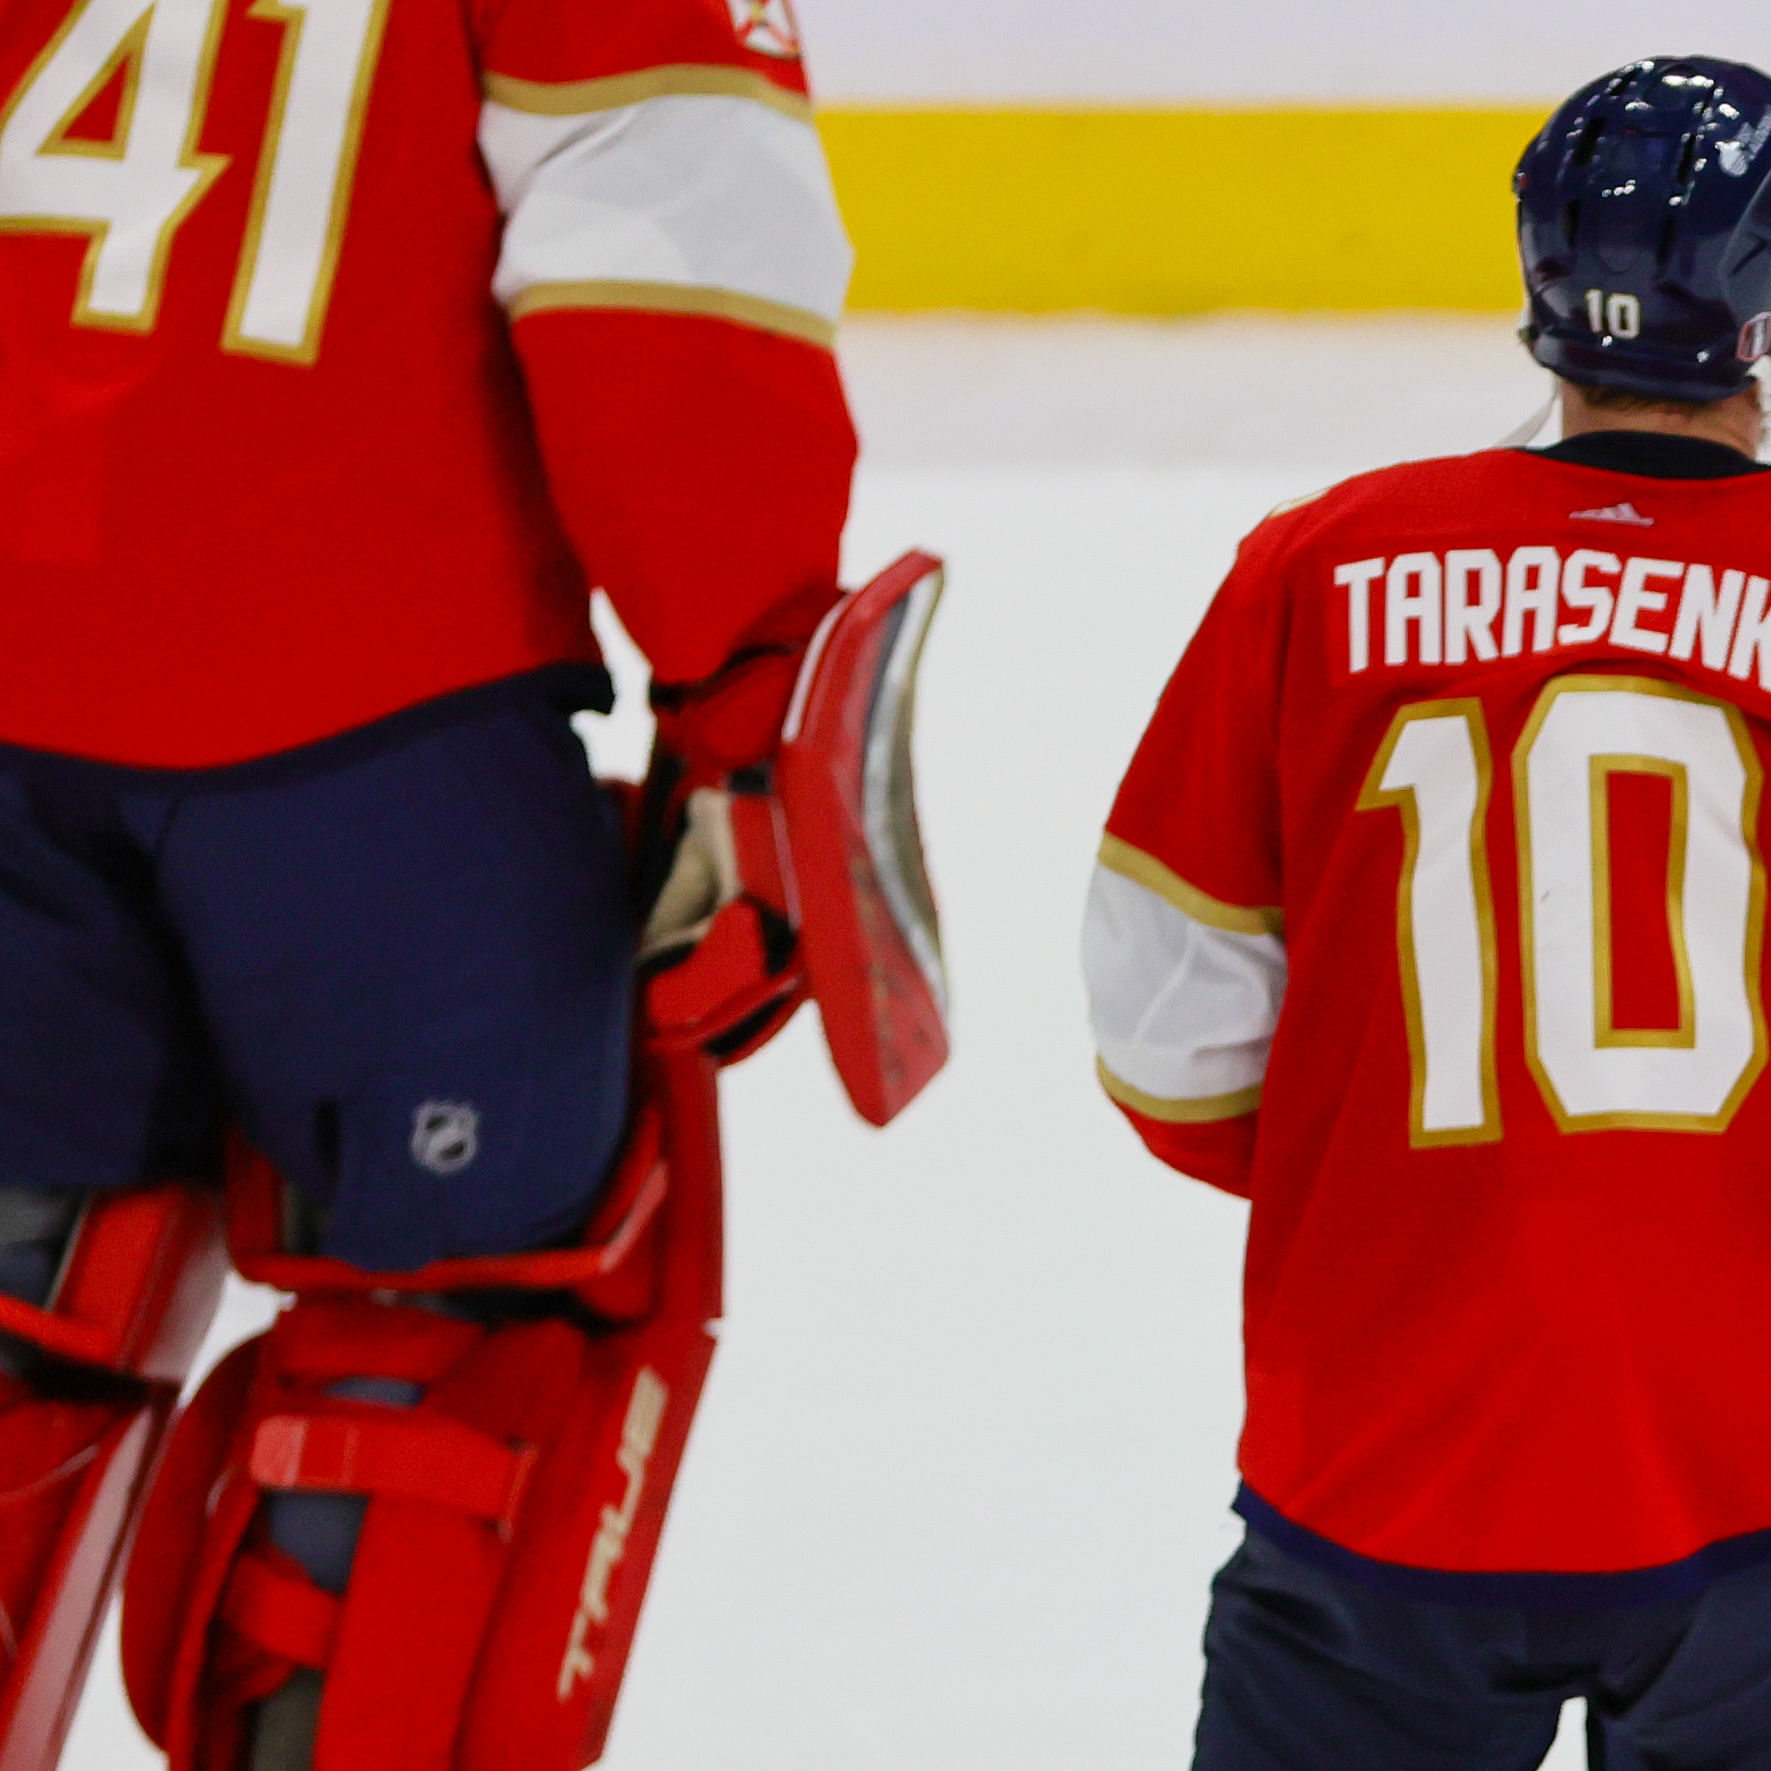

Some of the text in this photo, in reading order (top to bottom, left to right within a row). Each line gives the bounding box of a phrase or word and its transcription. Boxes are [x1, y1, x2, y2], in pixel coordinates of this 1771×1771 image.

[0, 0, 388, 366] 41
[1585, 289, 1641, 339] 10
[1355, 675, 1769, 1148] 10
[557, 1365, 670, 1701] TRUE
